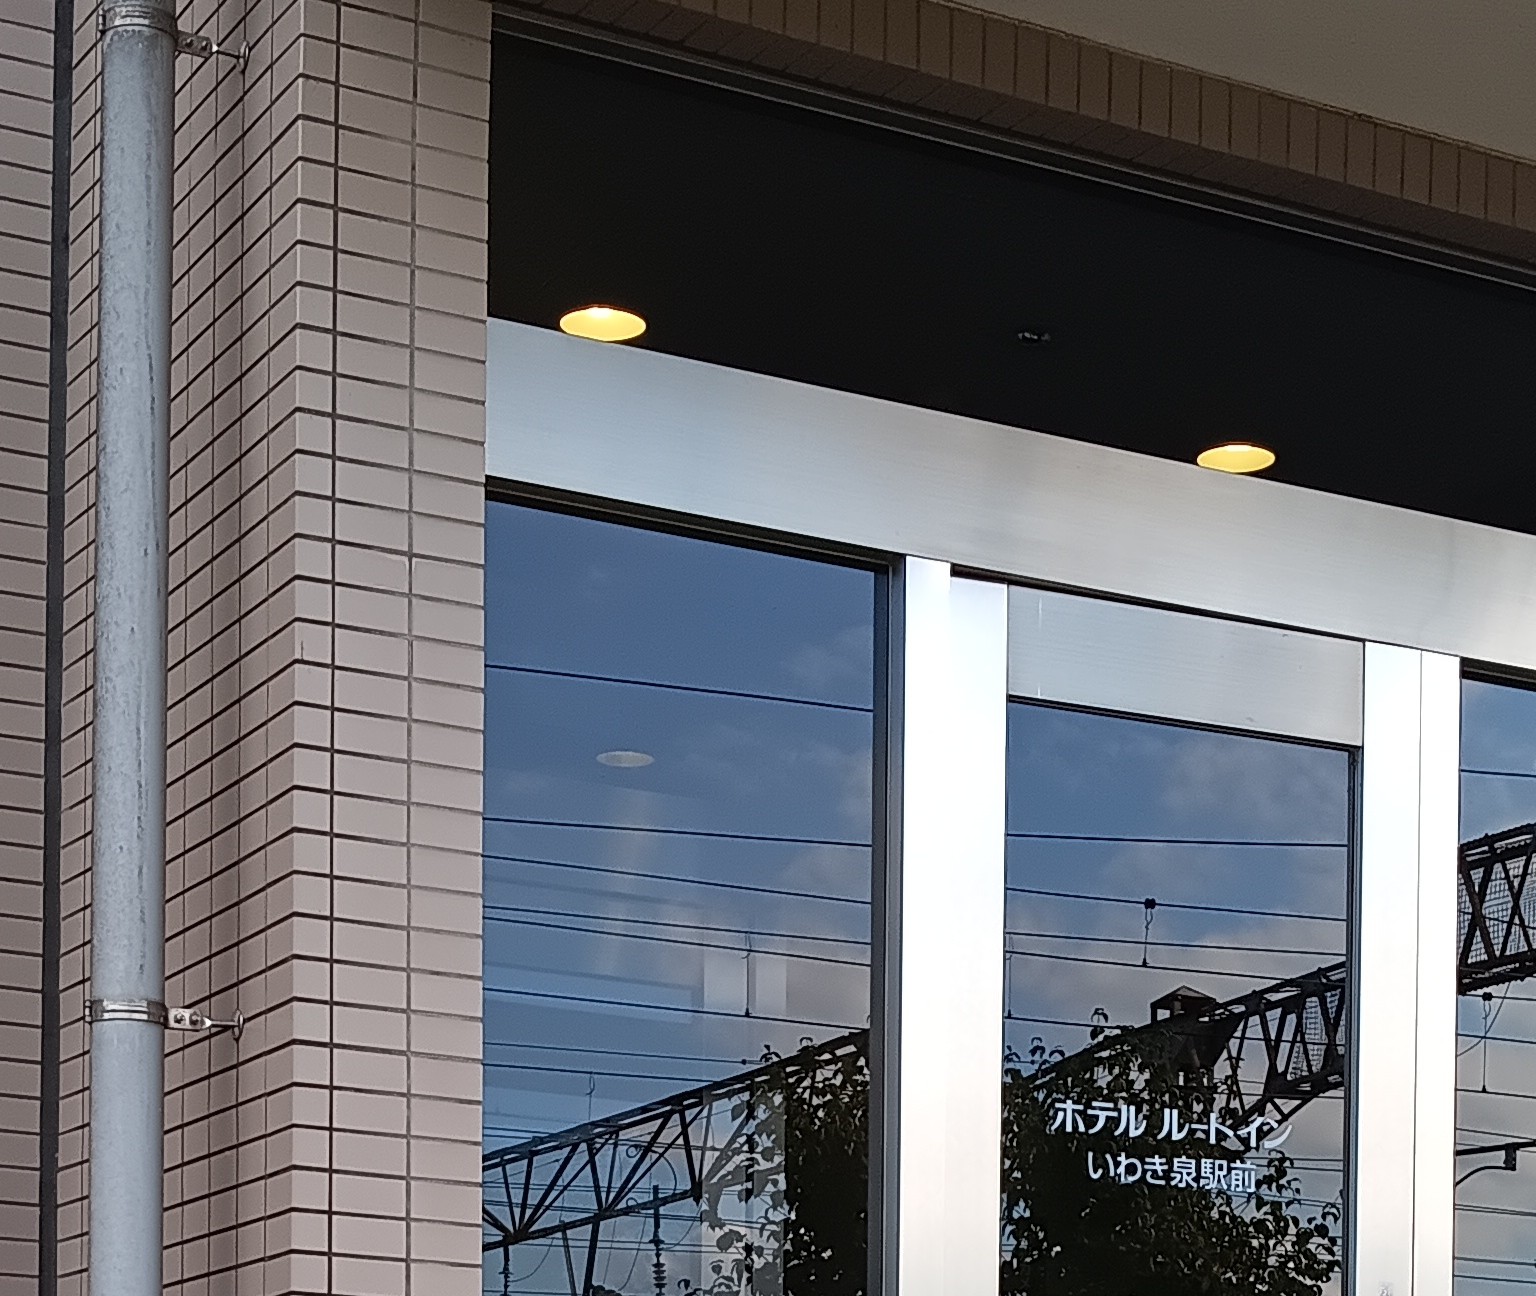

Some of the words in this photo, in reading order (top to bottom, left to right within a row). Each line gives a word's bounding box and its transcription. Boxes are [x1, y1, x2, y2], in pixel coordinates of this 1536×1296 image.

[1051, 1099, 1147, 1138] ホテル
[1157, 1108, 1293, 1149] ルートイン
[1087, 1151, 1257, 1193] いわき泉駅前
